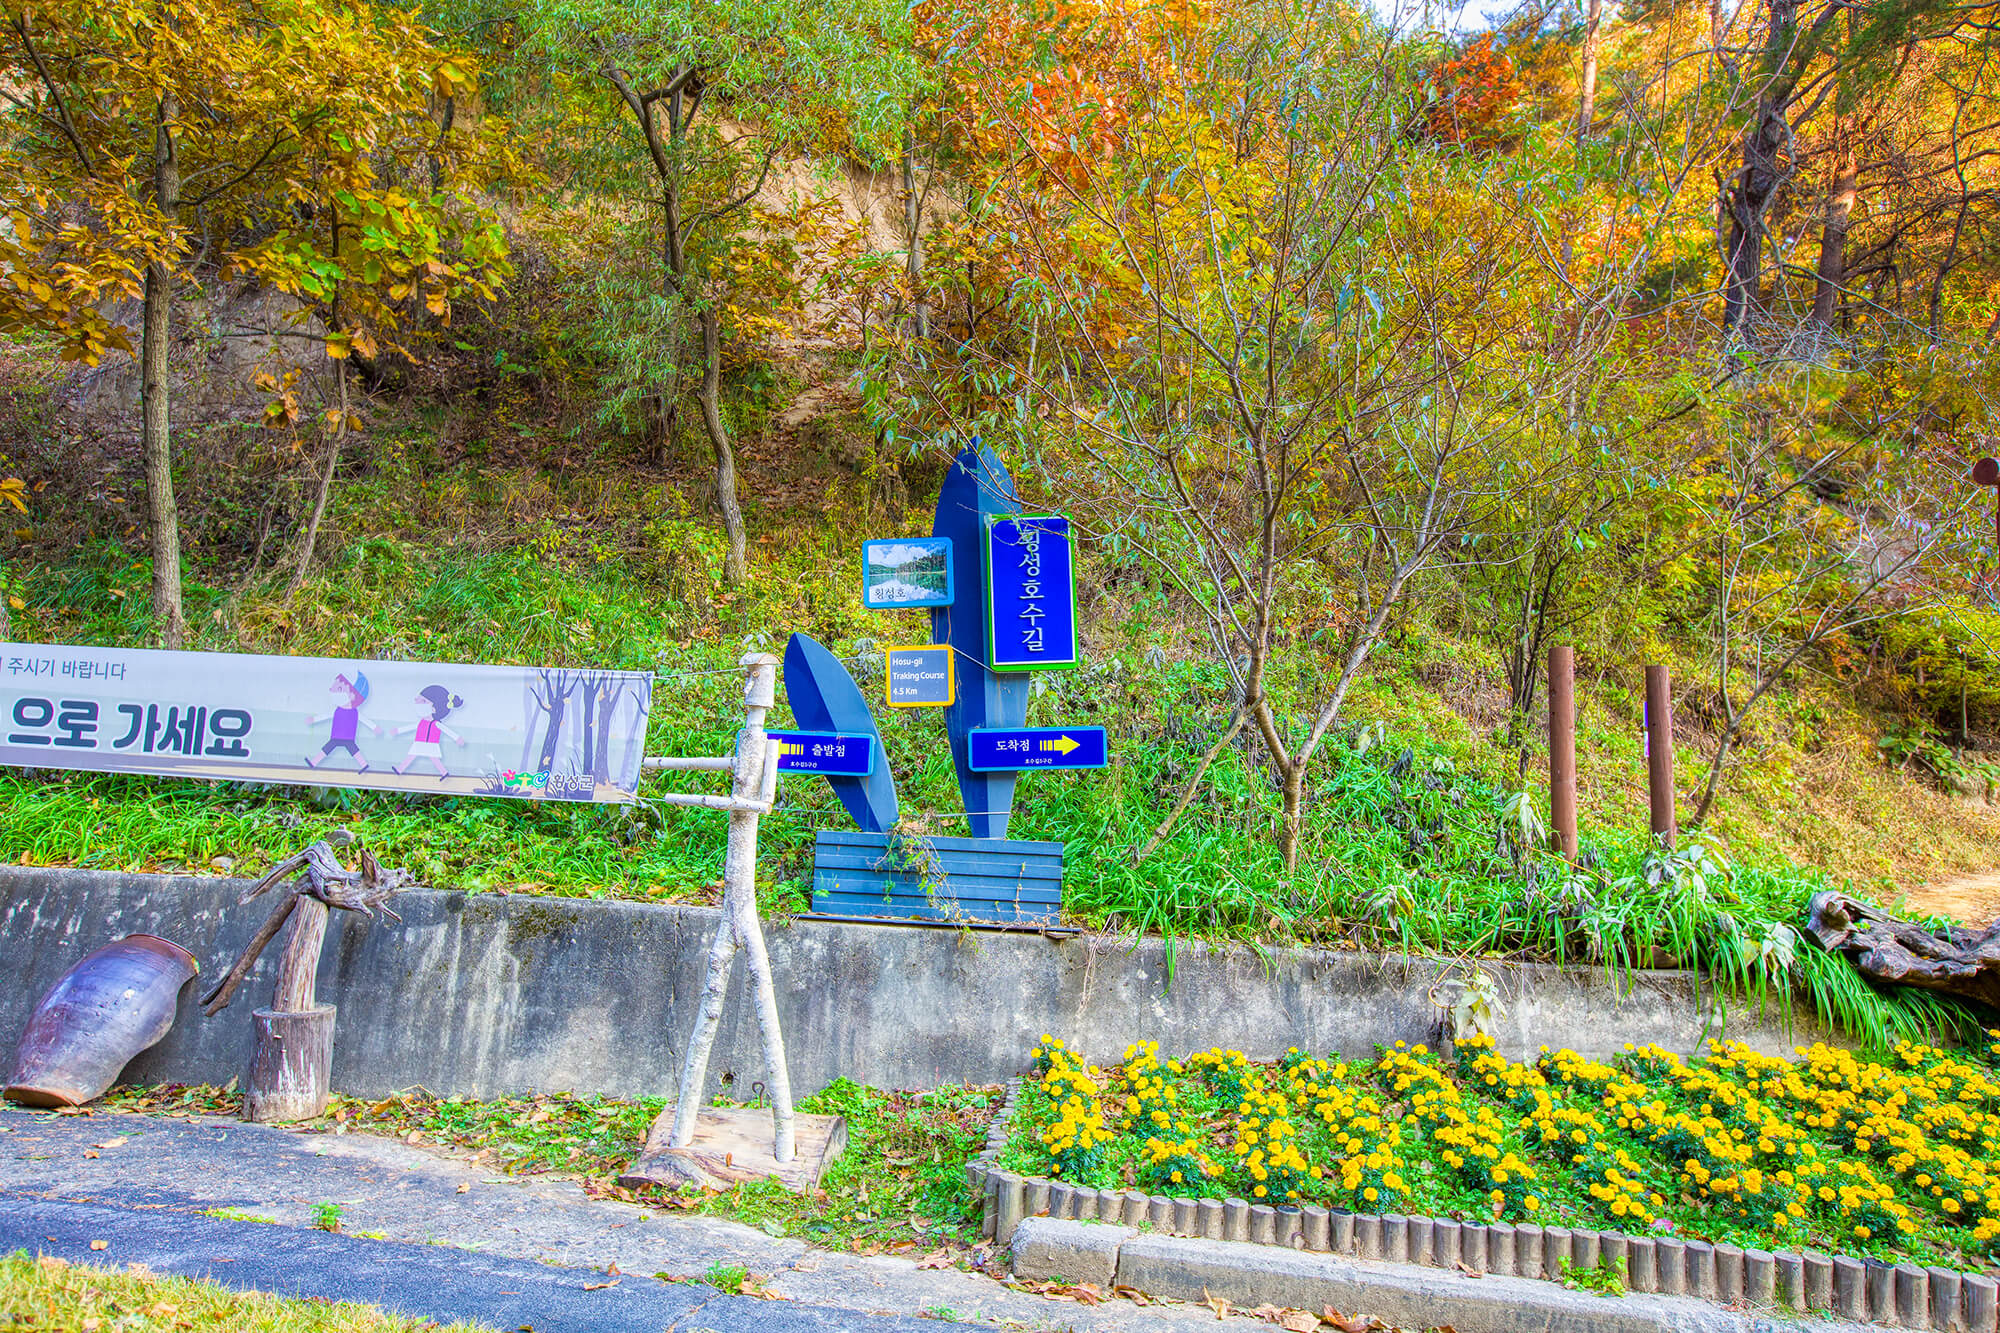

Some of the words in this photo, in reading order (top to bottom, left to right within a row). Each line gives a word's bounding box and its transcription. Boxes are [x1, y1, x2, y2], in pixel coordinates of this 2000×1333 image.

[874, 587, 906, 600] 횡성호
[1018, 528, 1046, 652] 횡성호수길
[7, 657, 55, 678] 주시기
[62, 659, 127, 681] 바랍니다
[892, 657, 923, 668] Hosu-gil
[892, 671, 920, 682] Traking
[920, 671, 945, 680] Course
[892, 687, 905, 696] 4.5
[905, 687, 918, 696] Km
[8, 697, 99, 748] 으로
[113, 703, 252, 757] 가세요
[811, 743, 846, 758] 출발점
[995, 738, 1030, 752] 도착점
[552, 773, 594, 791] 횡성군
